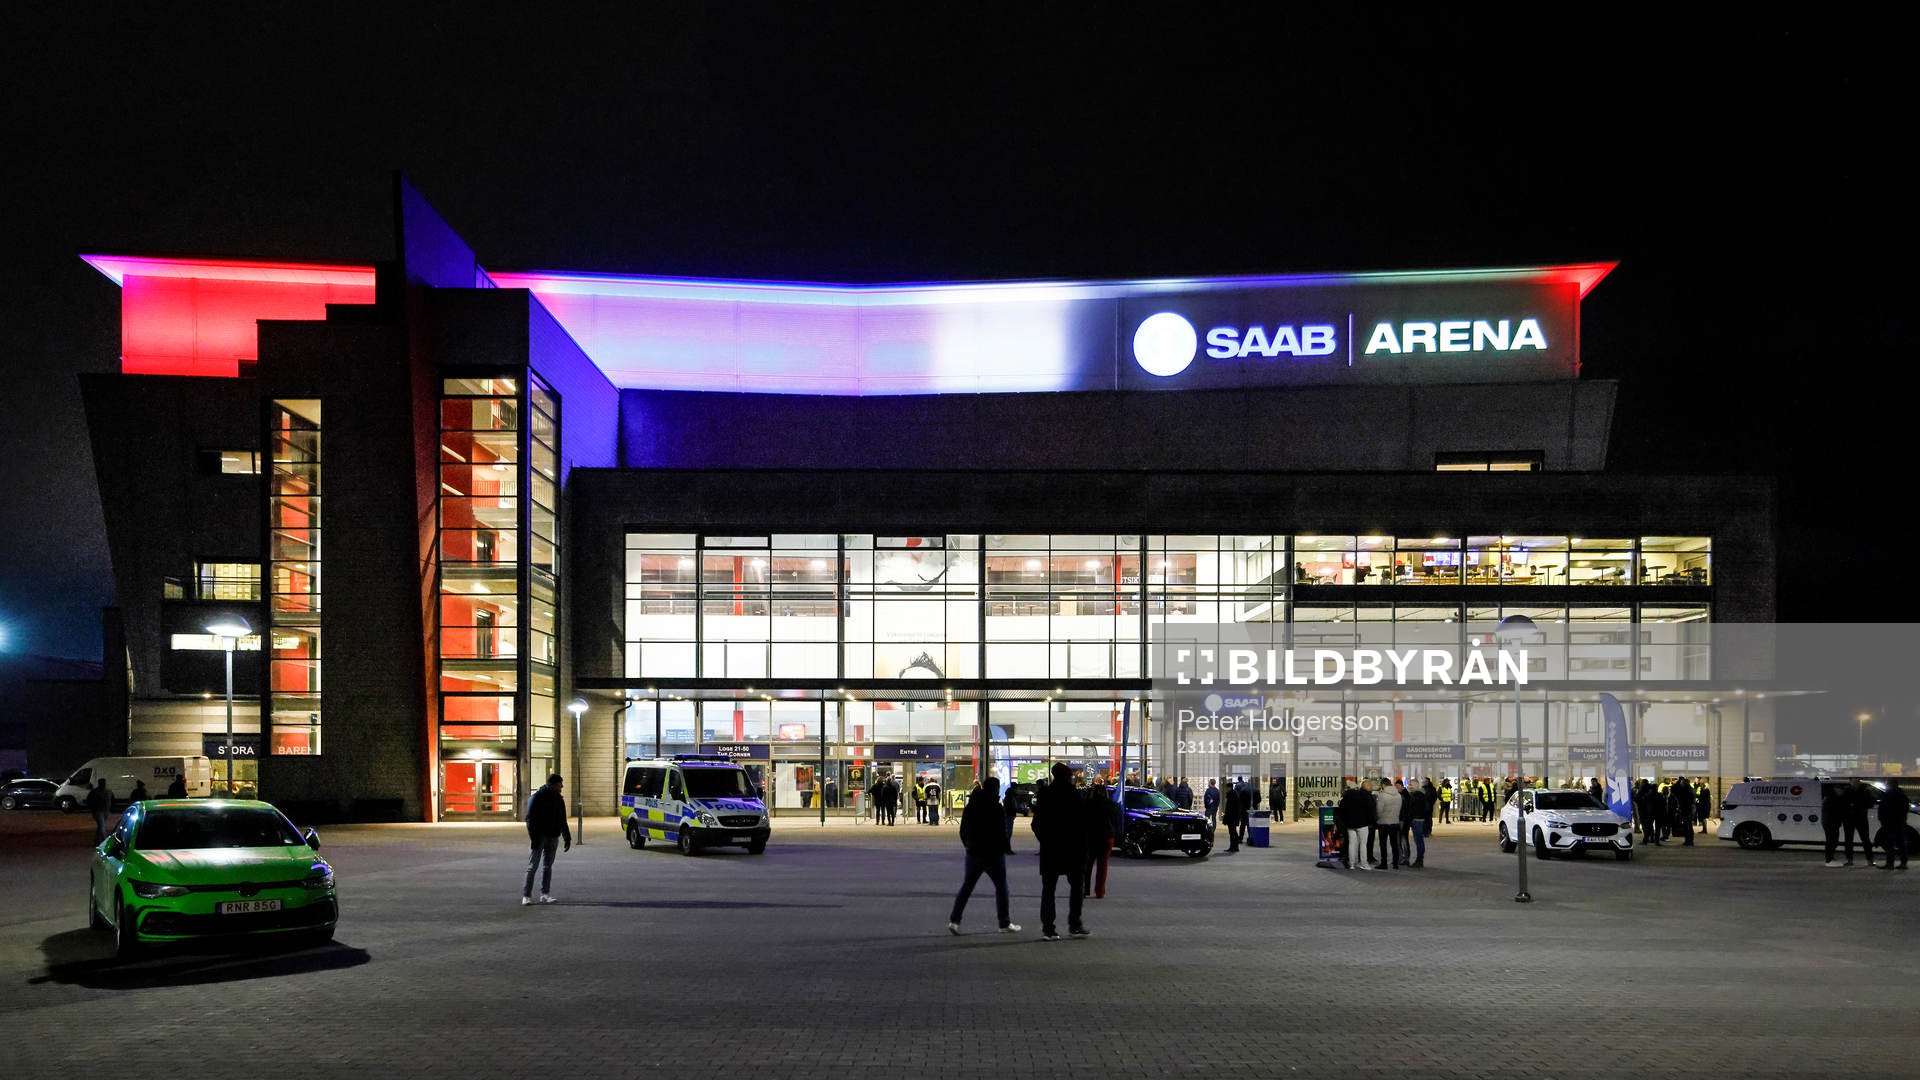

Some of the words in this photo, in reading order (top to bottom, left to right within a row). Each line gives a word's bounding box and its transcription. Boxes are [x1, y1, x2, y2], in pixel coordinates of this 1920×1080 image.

[1206, 325, 1336, 359] SAAB
[1364, 319, 1548, 355] ARENA
[217, 746, 255, 755] SORA
[1644, 749, 1706, 758] KUNDCENTER
[1297, 776, 1339, 789] OMFORT
[1750, 785, 1788, 795] COMFORT
[226, 902, 250, 913] RNR
